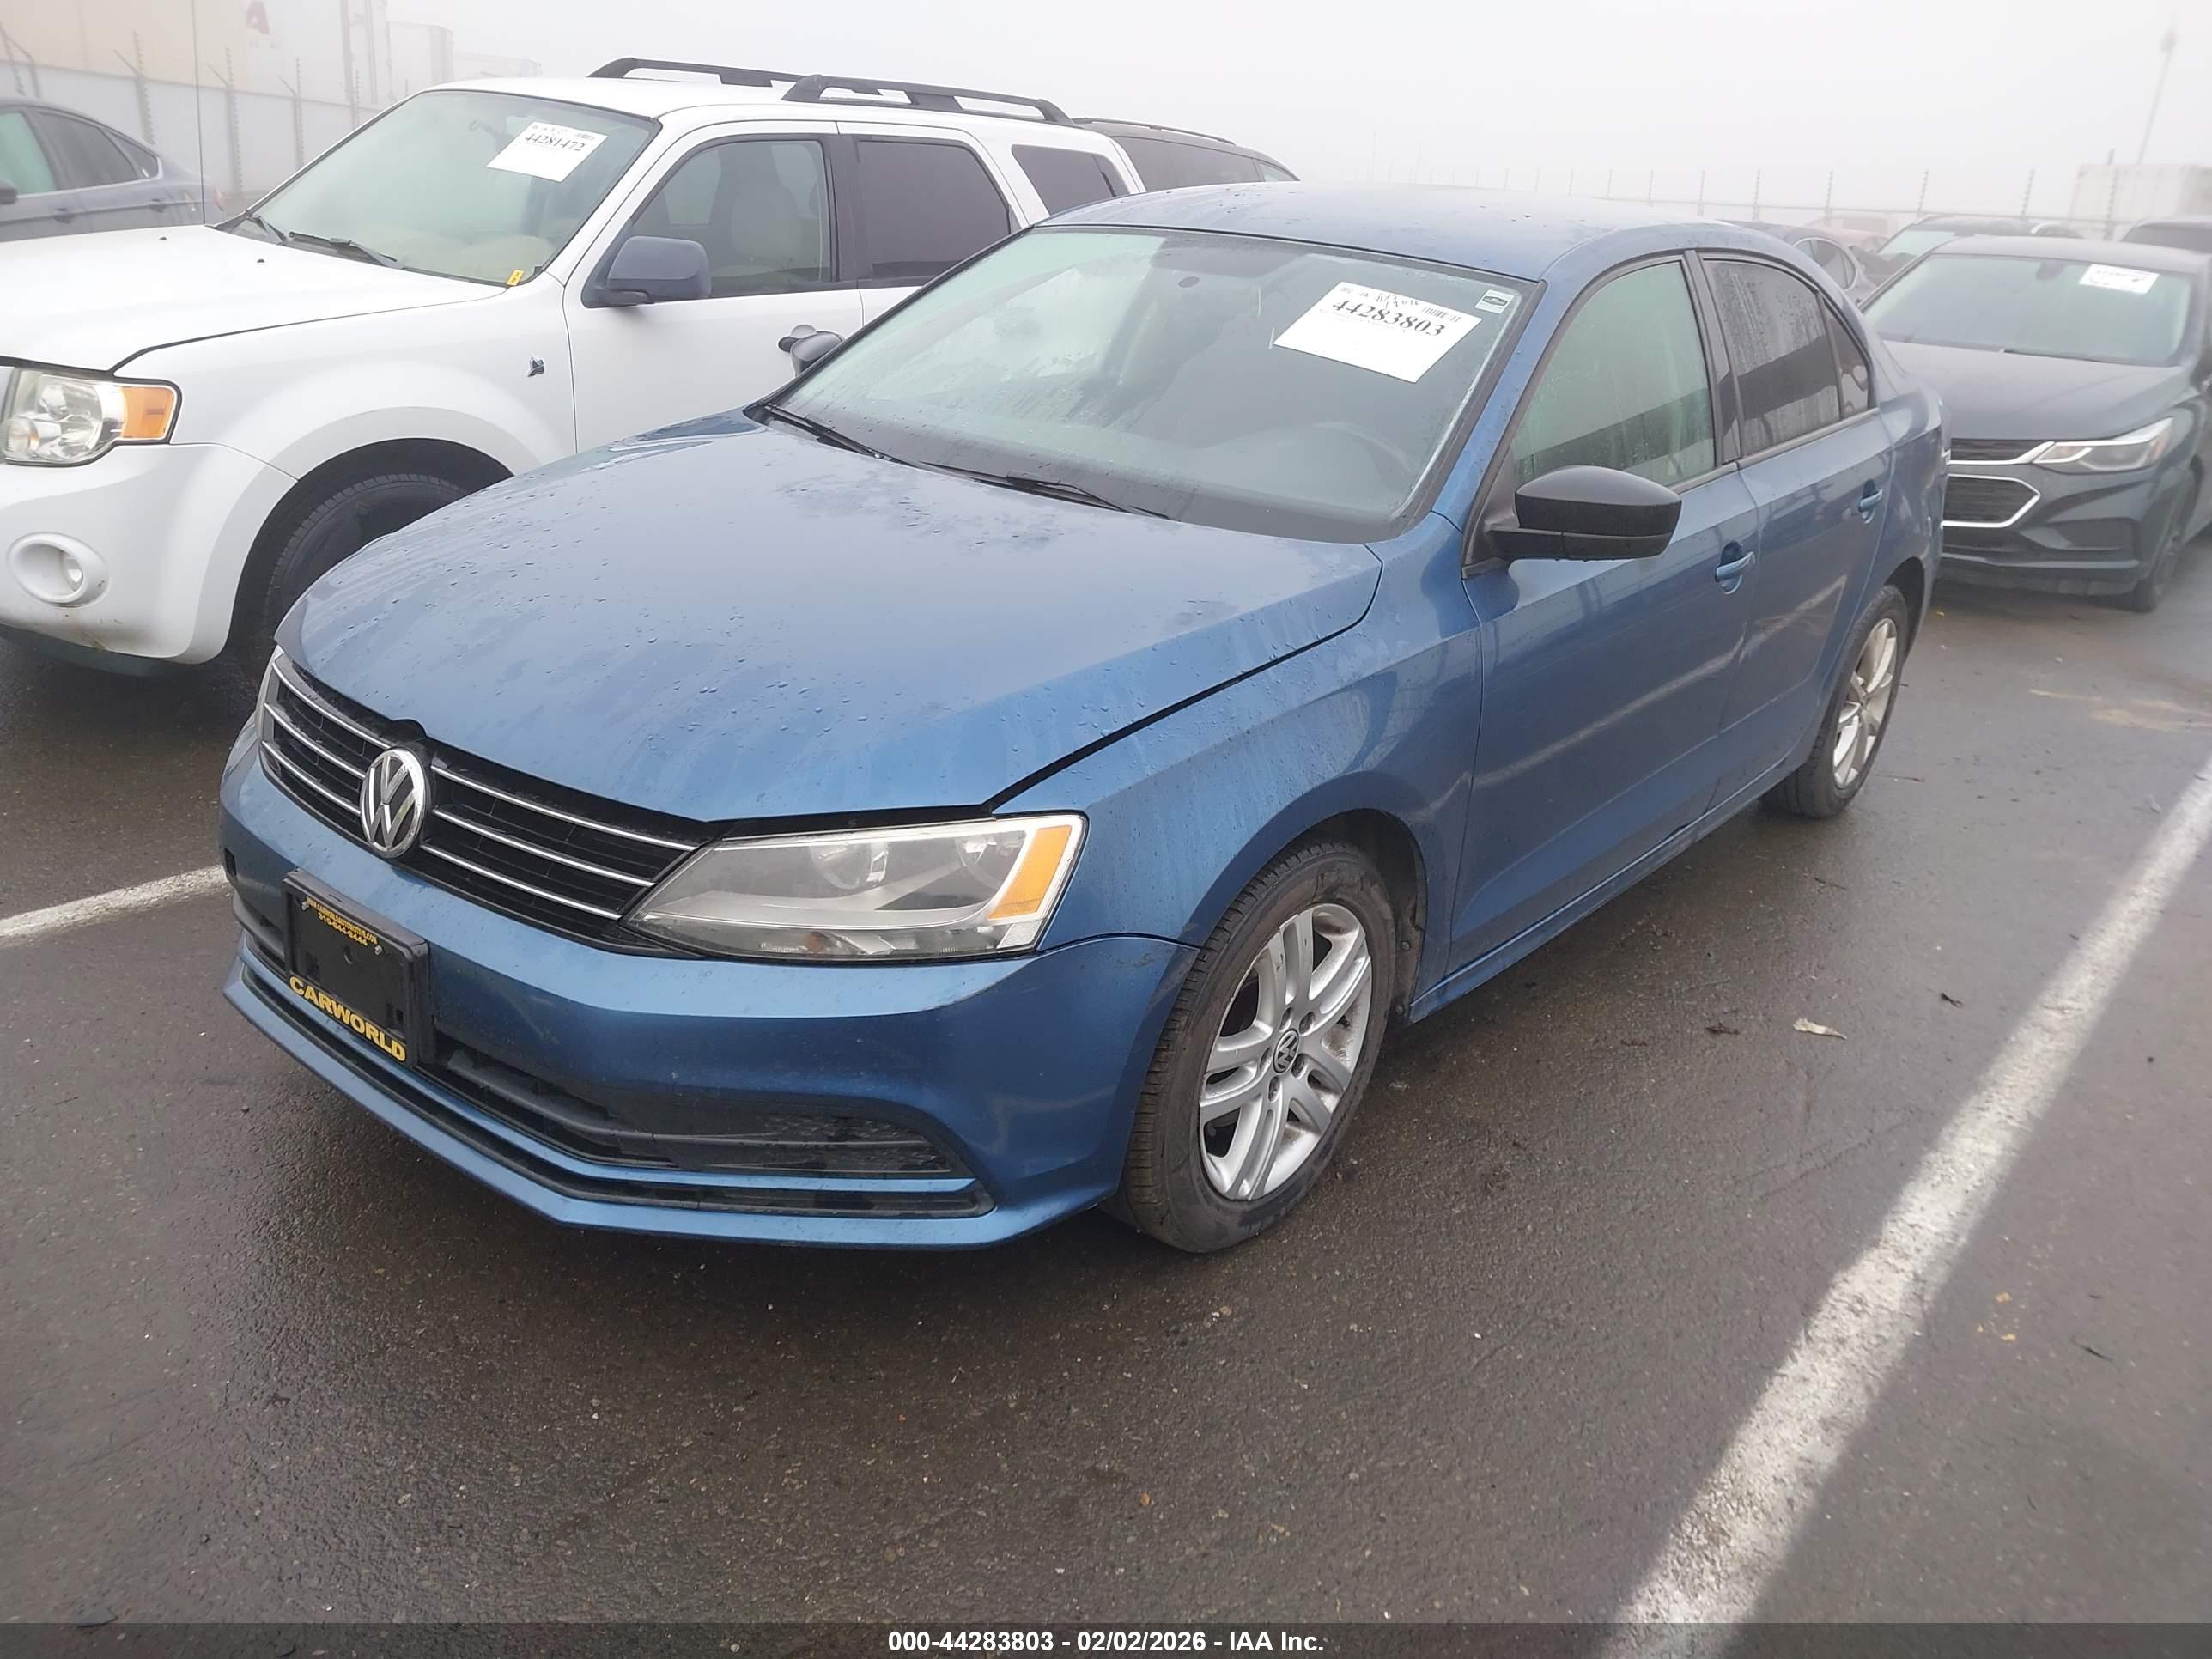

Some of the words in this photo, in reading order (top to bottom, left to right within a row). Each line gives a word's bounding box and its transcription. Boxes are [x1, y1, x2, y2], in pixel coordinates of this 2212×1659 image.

[525, 133, 586, 152] 44281472
[1332, 299, 1447, 337] 44283803
[289, 975, 407, 1063] CARWORLD
